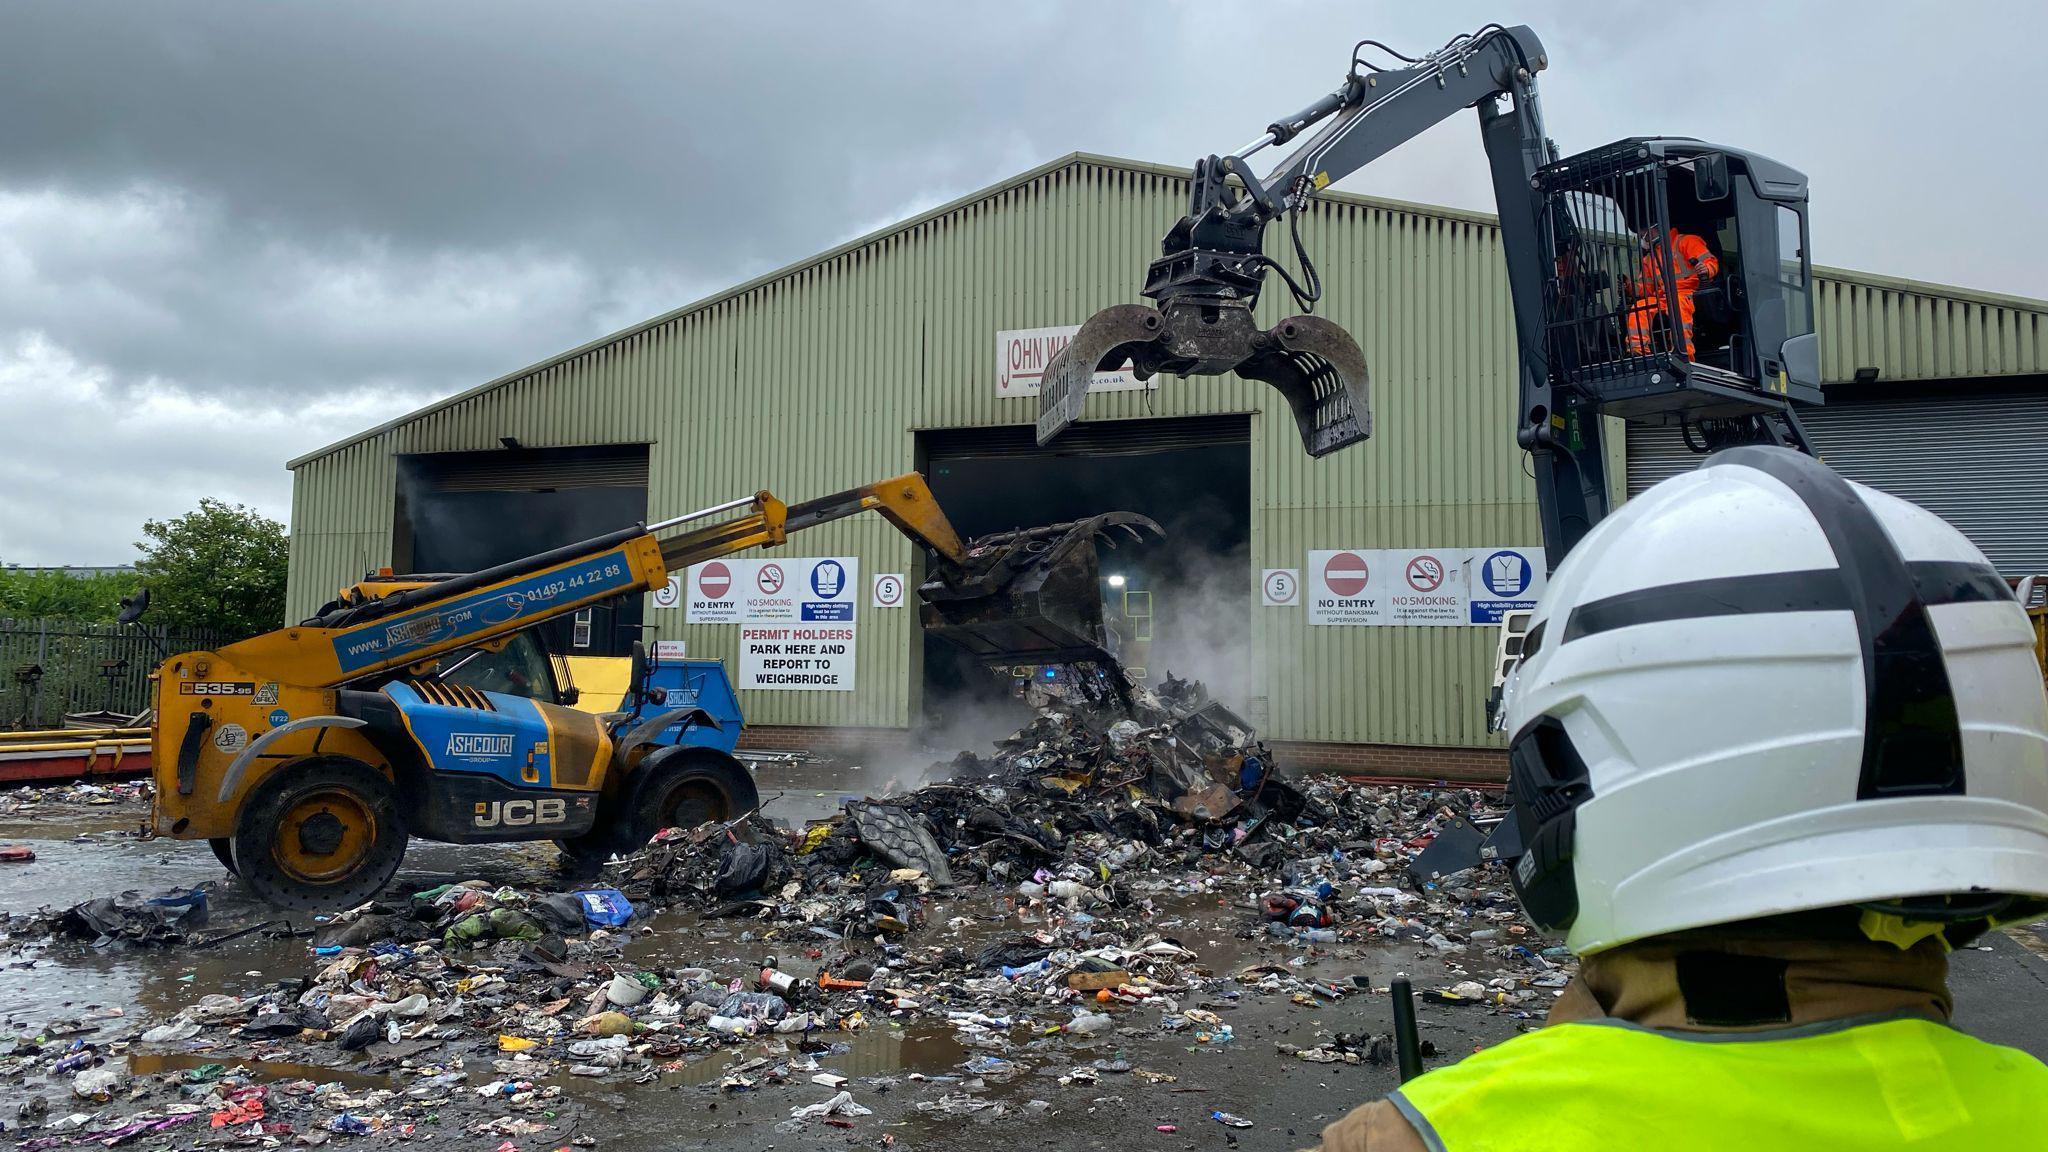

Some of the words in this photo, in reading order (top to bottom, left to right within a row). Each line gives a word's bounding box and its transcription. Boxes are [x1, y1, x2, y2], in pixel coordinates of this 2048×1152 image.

[1001, 337, 1042, 389] JOHN
[527, 582, 566, 601] 01482
[569, 575, 585, 588] 44
[587, 569, 603, 584] 22
[605, 564, 620, 578] 88
[885, 582, 892, 594] 5
[1276, 578, 1285, 591] 5
[693, 601, 706, 609] NO
[707, 601, 735, 609] ENTRY
[1318, 599, 1335, 608] NO
[1338, 599, 1375, 608] ENTRY
[1392, 597, 1408, 606] NO
[743, 629, 790, 640] PERMIT
[793, 629, 853, 640] HOLDERS
[750, 644, 781, 655] PARK
[785, 644, 816, 655] HERE
[820, 644, 846, 655] AND
[763, 659, 811, 669] REPORT
[814, 659, 831, 669] TO
[755, 674, 839, 685] WEIGHBRIDGE
[445, 733, 516, 756] ASHCOURT
[474, 798, 567, 828] JCB
